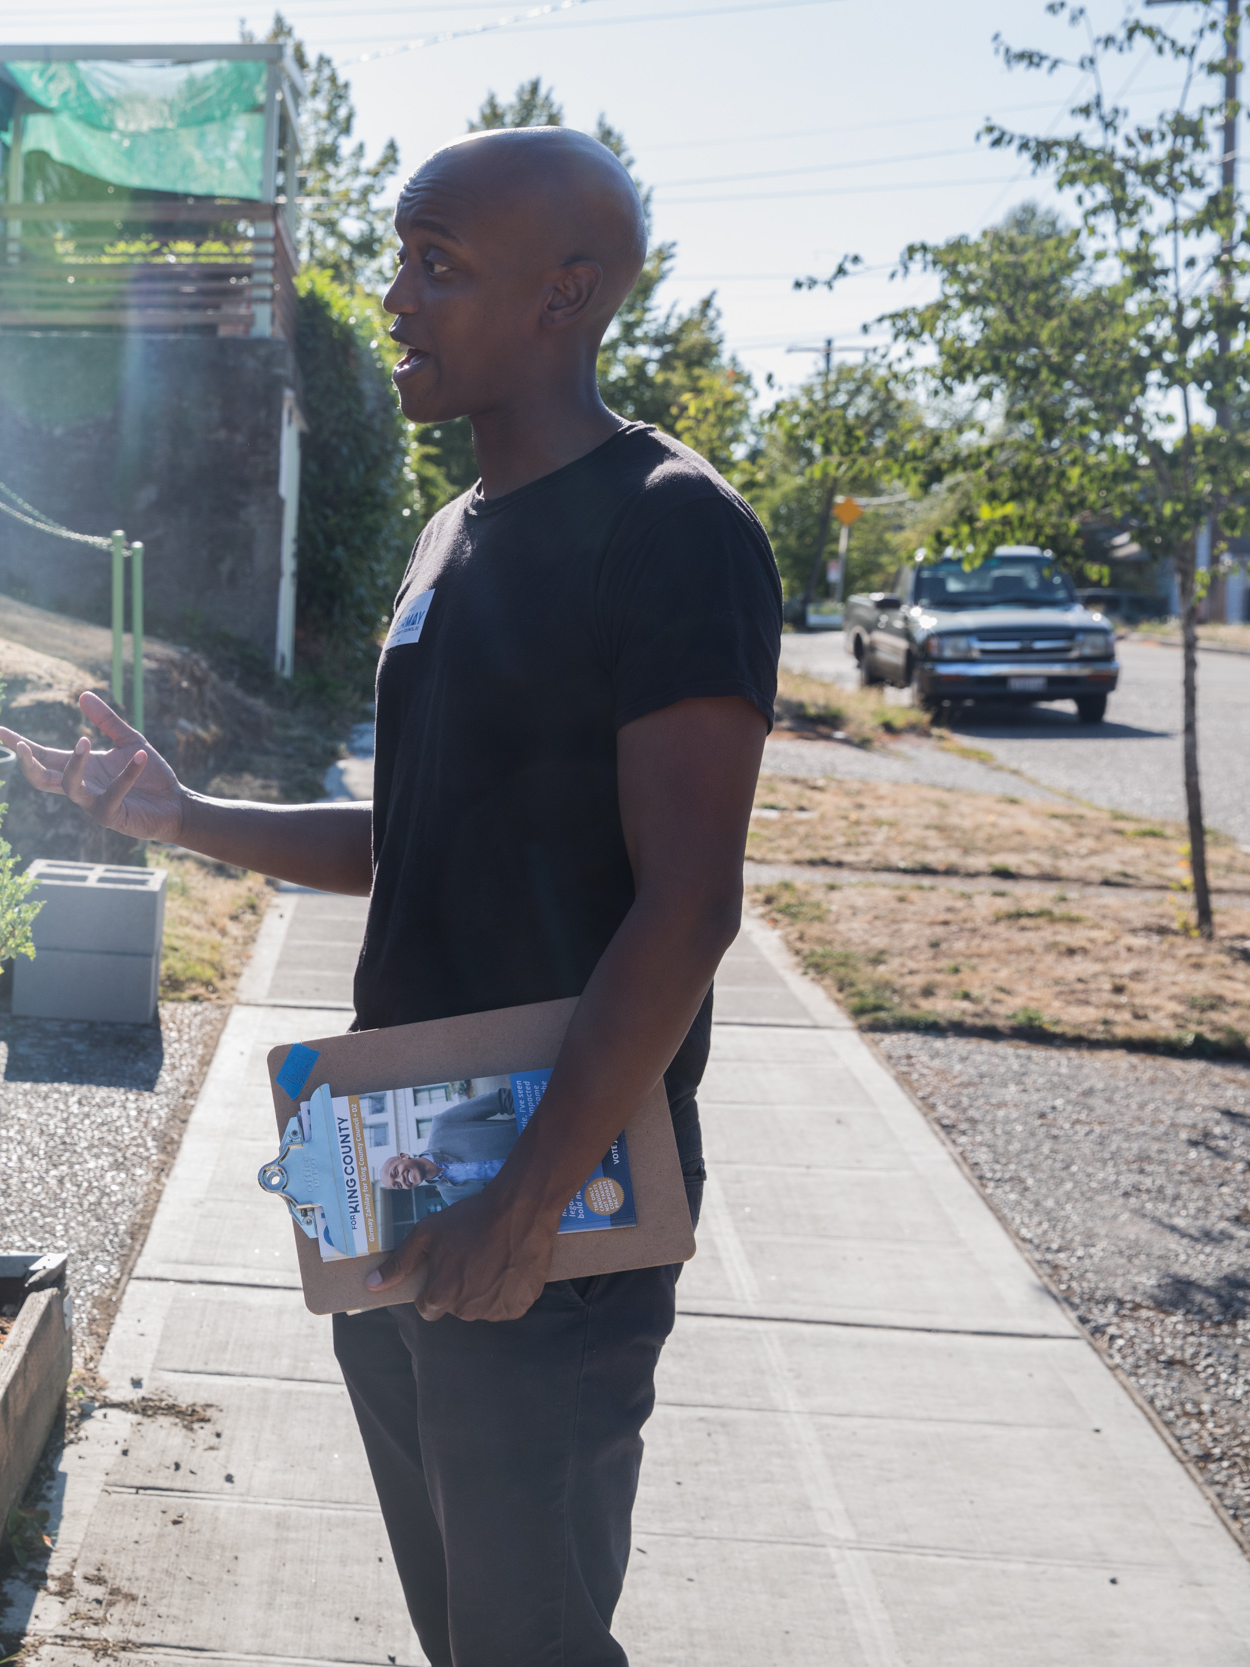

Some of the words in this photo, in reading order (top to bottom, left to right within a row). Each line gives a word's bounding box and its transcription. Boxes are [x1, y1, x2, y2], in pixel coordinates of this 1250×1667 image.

[516, 1080, 524, 1098] seen
[351, 1103, 358, 1113] D2
[353, 1117, 362, 1142] Council
[337, 1117, 355, 1176] COUNTY
[357, 1143, 365, 1166] County
[611, 1145, 620, 1165] VOTE
[360, 1166, 368, 1182] King
[345, 1178, 360, 1214] KING
[364, 1193, 372, 1217] Zahilay
[577, 1201, 585, 1219] bold
[367, 1218, 375, 1242] Girmay
